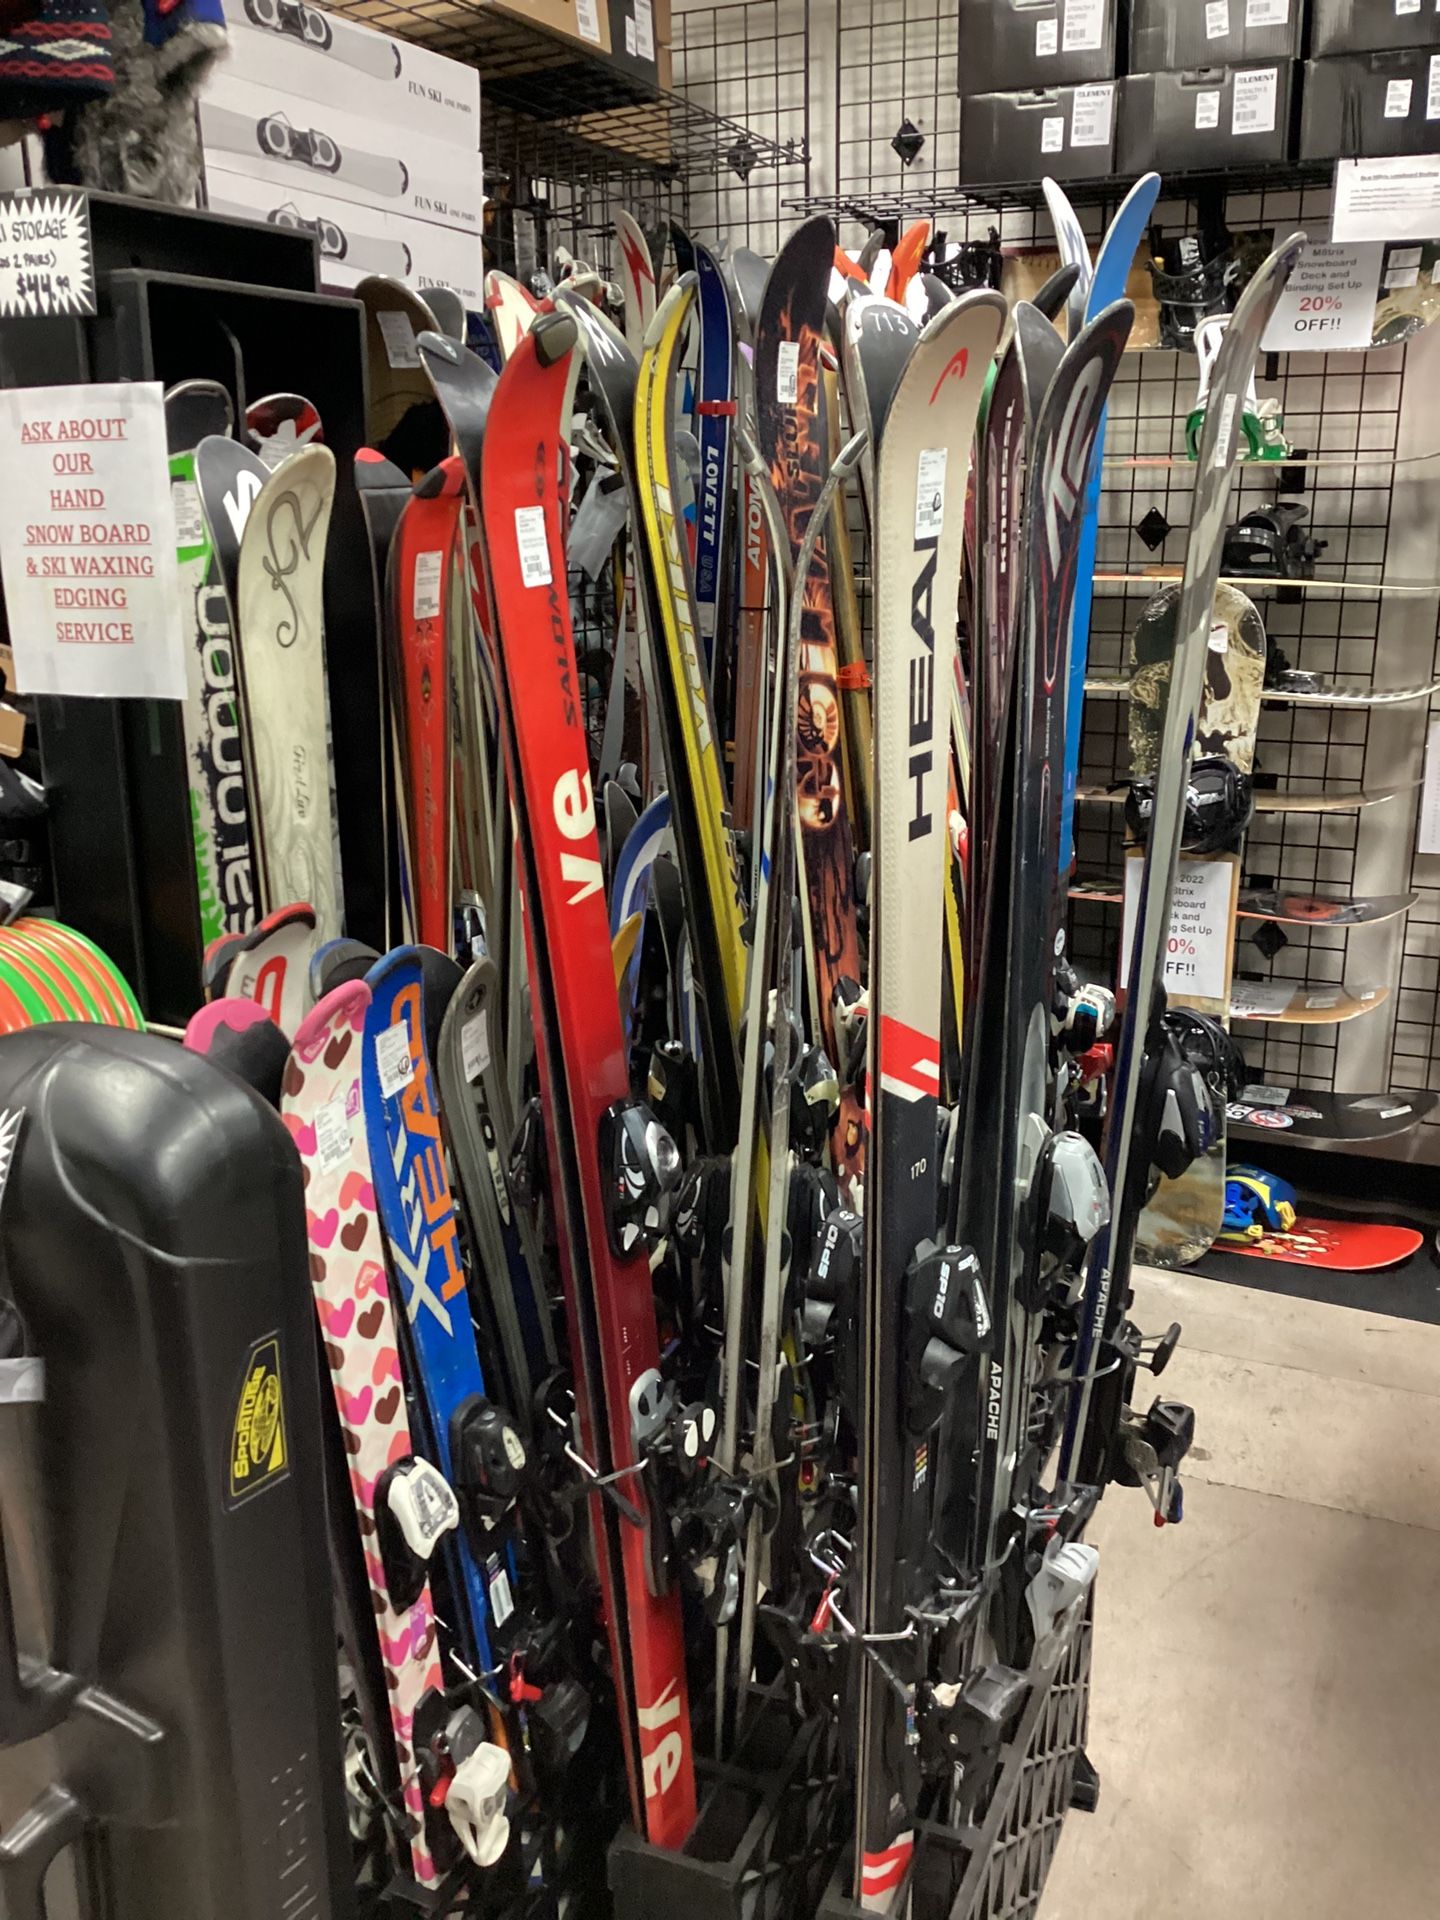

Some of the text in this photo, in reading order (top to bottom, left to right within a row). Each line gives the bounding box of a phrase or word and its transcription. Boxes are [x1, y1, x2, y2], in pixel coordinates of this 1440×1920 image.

[408, 80, 426, 97] FUN
[427, 87, 442, 103] SKI
[414, 195, 431, 210] FUN
[434, 202, 447, 216] SKI
[12, 218, 68, 242] STORAGE
[14, 254, 22, 268] 2
[419, 276, 434, 288] FUN
[1301, 271, 1349, 280] Deck and
[1327, 282, 1344, 291] Set
[1348, 281, 1362, 290] Up
[1299, 296, 1342, 312] 20%
[1294, 318, 1341, 332] OFF!!
[21, 418, 127, 443] ASK ABOUT
[53, 453, 93, 474] OUR
[50, 489, 105, 509] HAND
[700, 446, 720, 594] LOVETT USA
[746, 479, 762, 570] ATOM
[26, 524, 151, 544] SNOW BOARD
[26, 556, 154, 576] & SKI WAXING
[54, 588, 127, 608] EDGING
[56, 622, 134, 642] SERVICE
[547, 585, 579, 728] SALOM
[1182, 913, 1200, 921] and
[1180, 924, 1196, 934] Set
[1199, 926, 1212, 936] Up
[1168, 938, 1195, 955] 0%
[1166, 962, 1195, 976] FF!!
[392, 982, 466, 1302] HEAD
[911, 1158, 926, 1180] 170
[817, 1225, 838, 1280] SP10
[934, 1261, 951, 1319] SP10
[1092, 1267, 1110, 1339] APACHE
[987, 1361, 1002, 1441] APACHE
